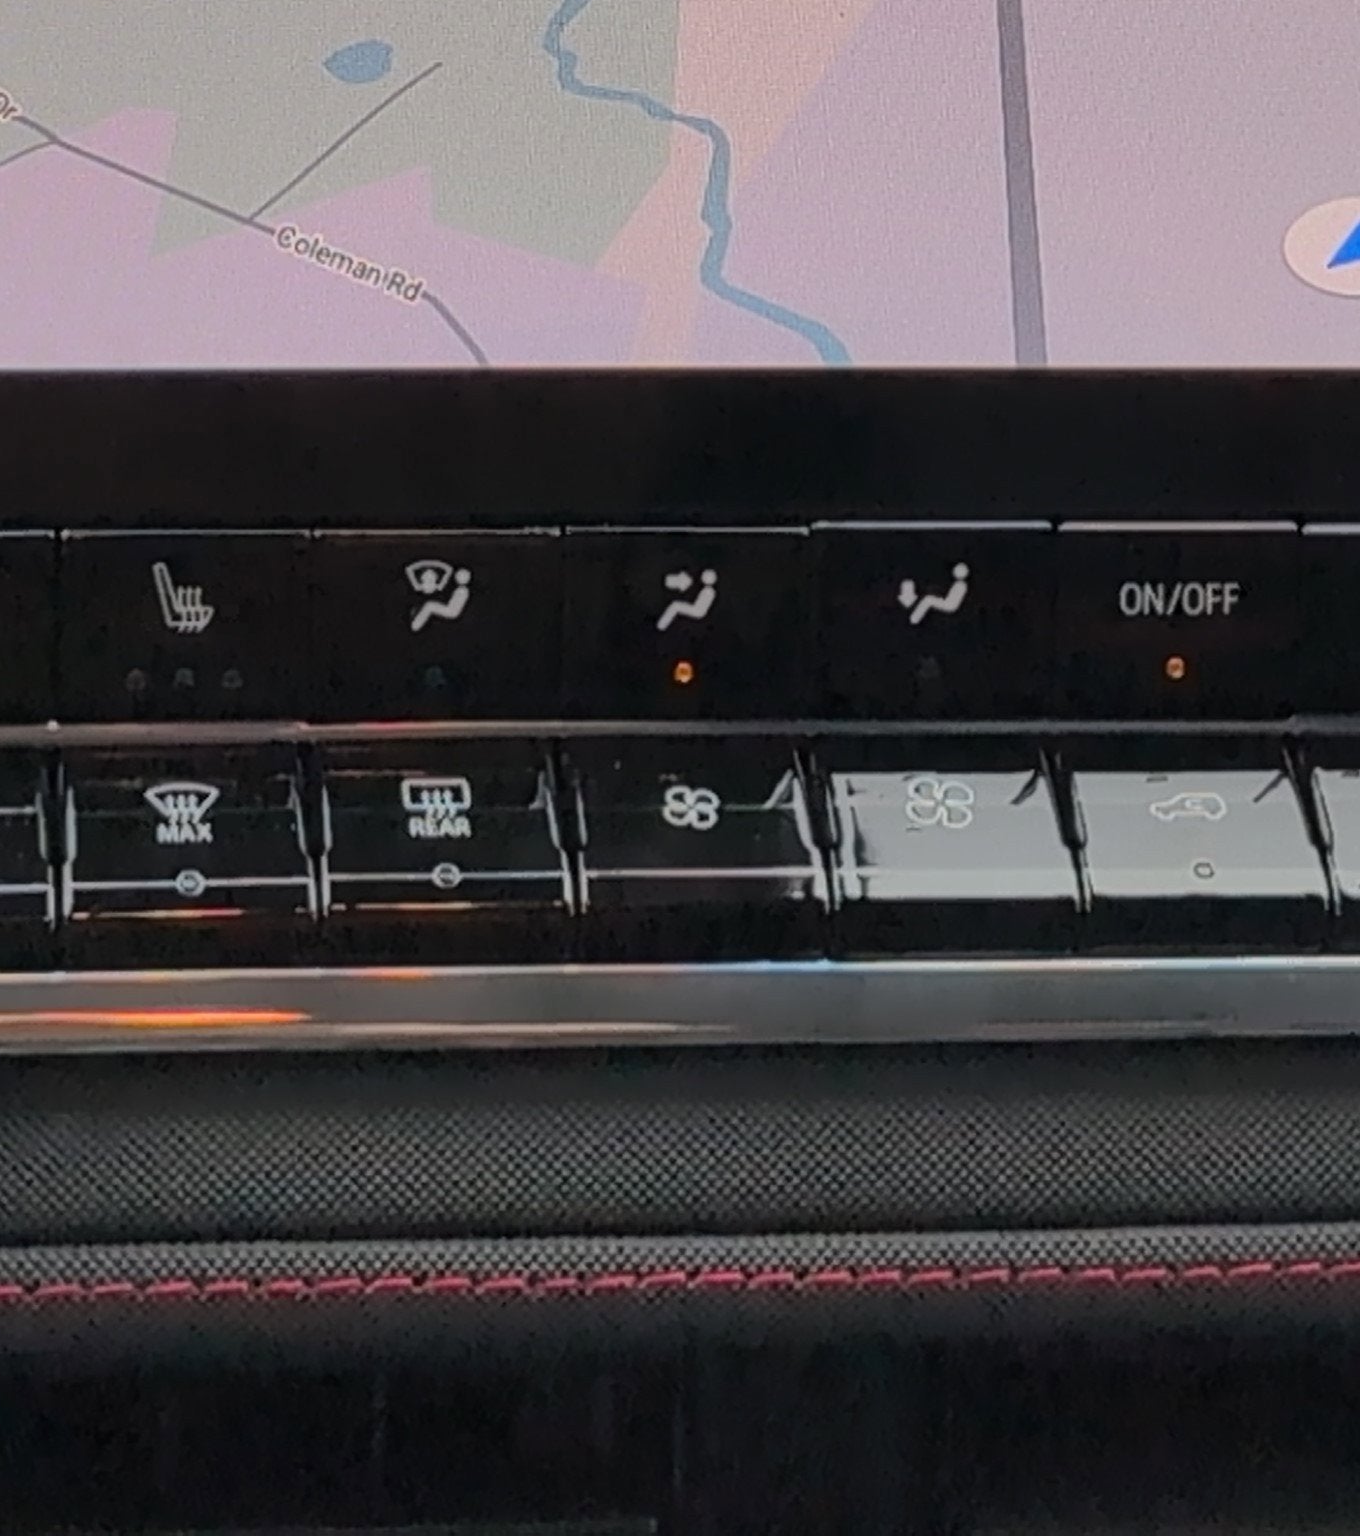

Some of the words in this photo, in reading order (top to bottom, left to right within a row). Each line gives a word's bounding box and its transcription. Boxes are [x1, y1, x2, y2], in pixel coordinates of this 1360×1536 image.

[277, 225, 382, 286] Coleman
[385, 269, 424, 302] Rd
[1119, 581, 1240, 618] ON/OFF
[155, 822, 213, 844] MAX
[408, 815, 471, 839] REAR
